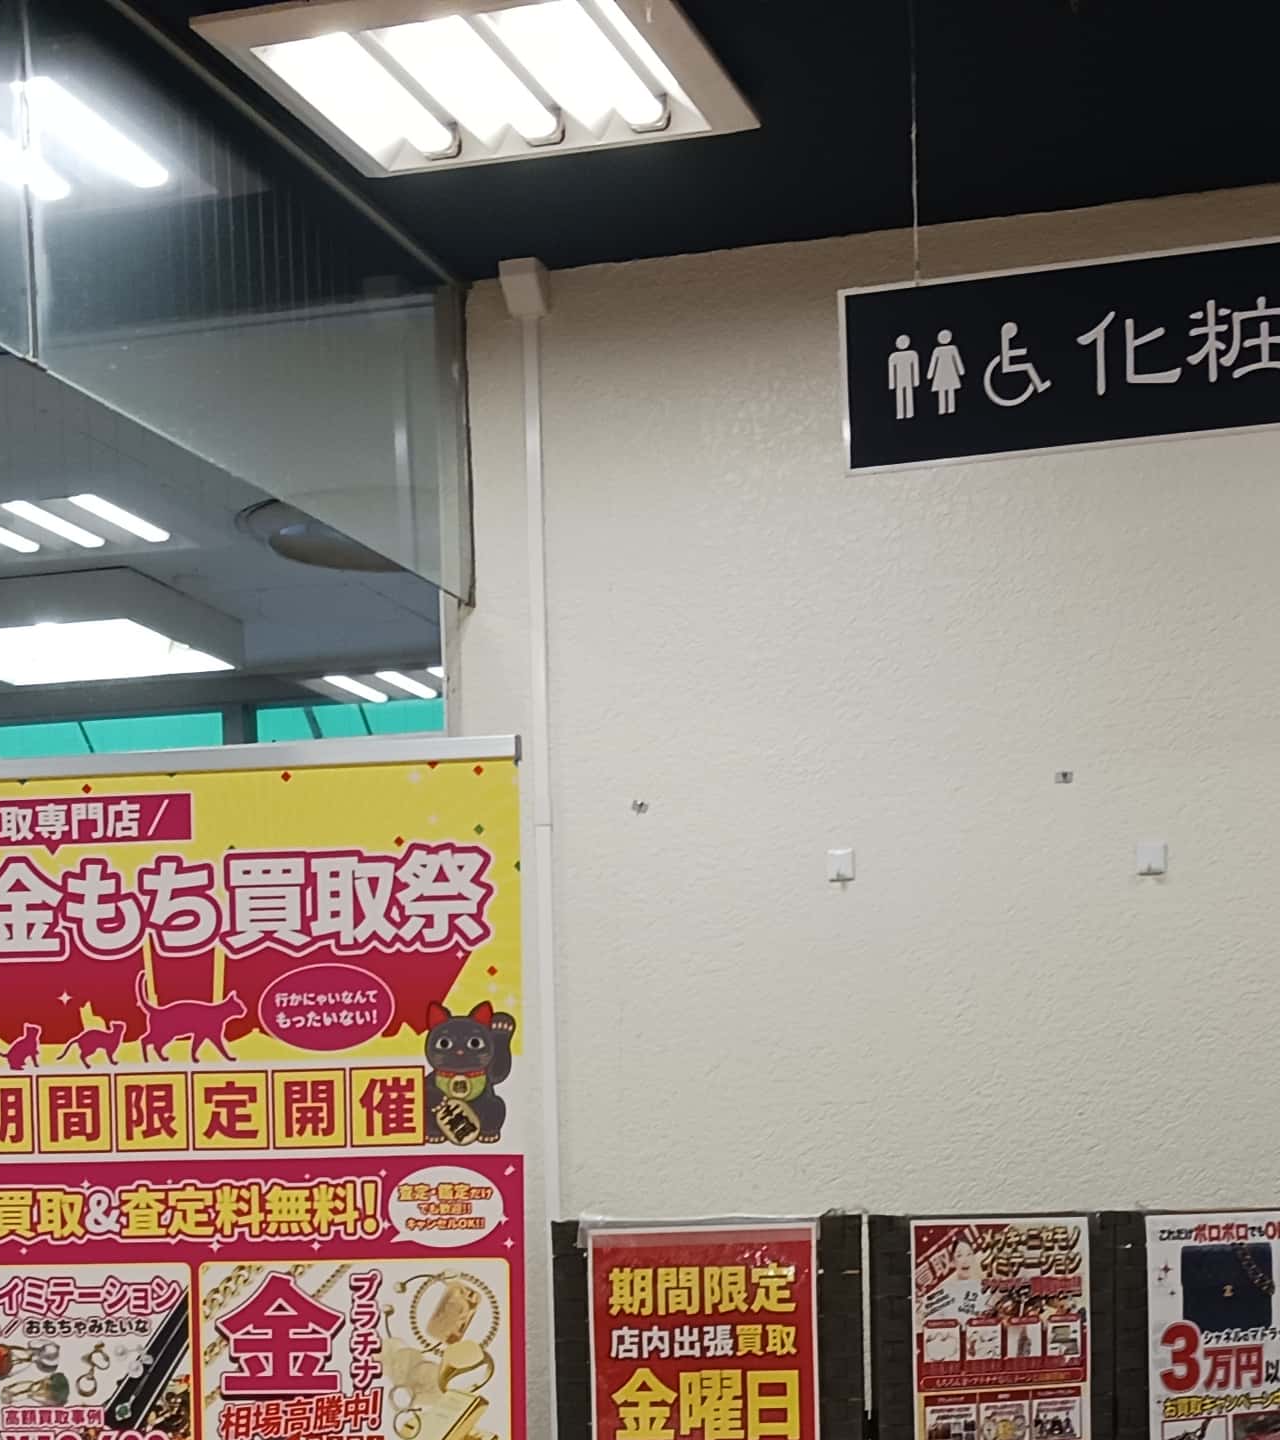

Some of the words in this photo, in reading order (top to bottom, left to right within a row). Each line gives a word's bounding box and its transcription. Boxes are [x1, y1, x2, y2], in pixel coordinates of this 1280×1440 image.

[274, 990, 378, 1007] 行かにゃいなんて
[276, 1009, 378, 1029] もったいない!
[608, 1264, 797, 1316] 期間限定
[217, 1272, 344, 1394] 金
[350, 1270, 381, 1386] プラチナ
[611, 1325, 797, 1359] 店内出張買取
